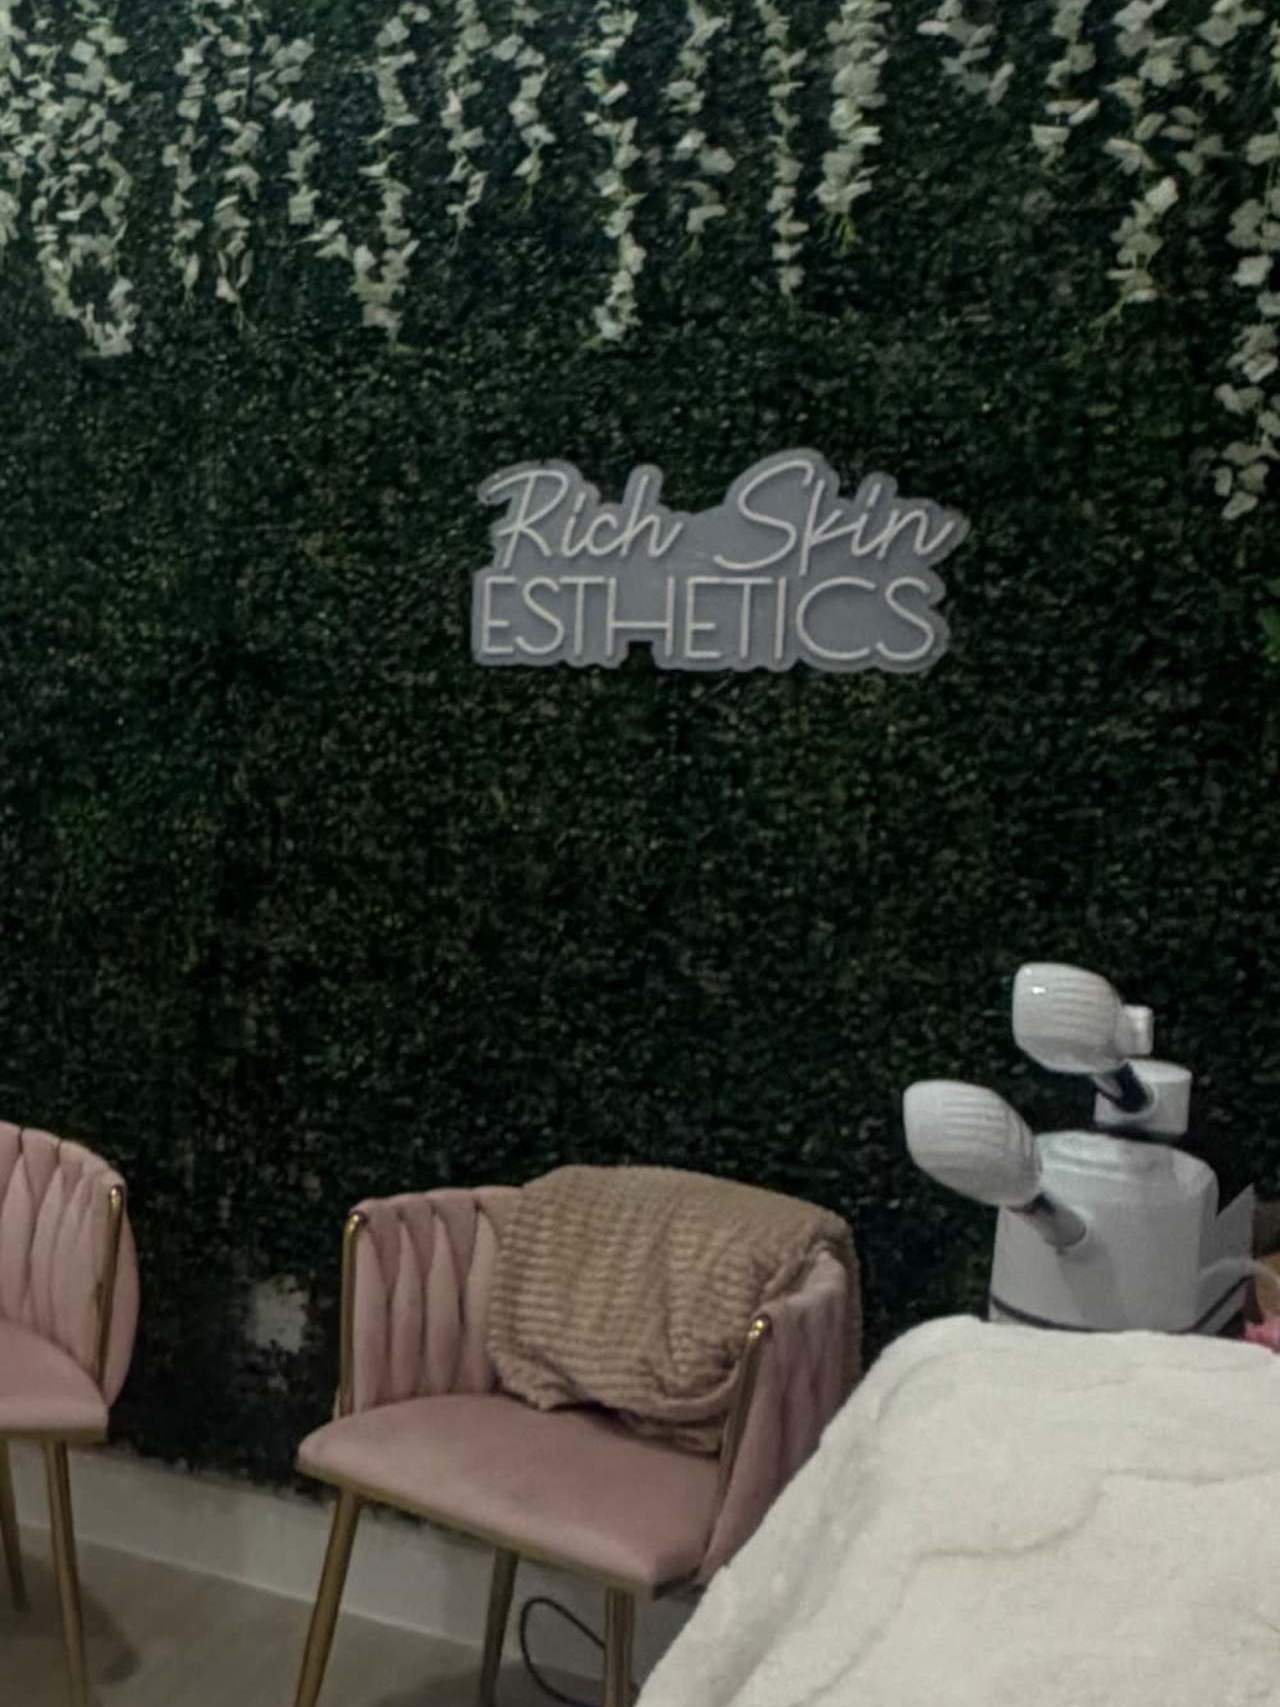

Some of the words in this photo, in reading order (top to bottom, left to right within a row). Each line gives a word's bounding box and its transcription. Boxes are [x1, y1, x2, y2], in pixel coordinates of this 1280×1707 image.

[485, 468, 684, 570] Rich
[713, 459, 955, 577] Skin
[480, 576, 936, 661] ESTHETICS
